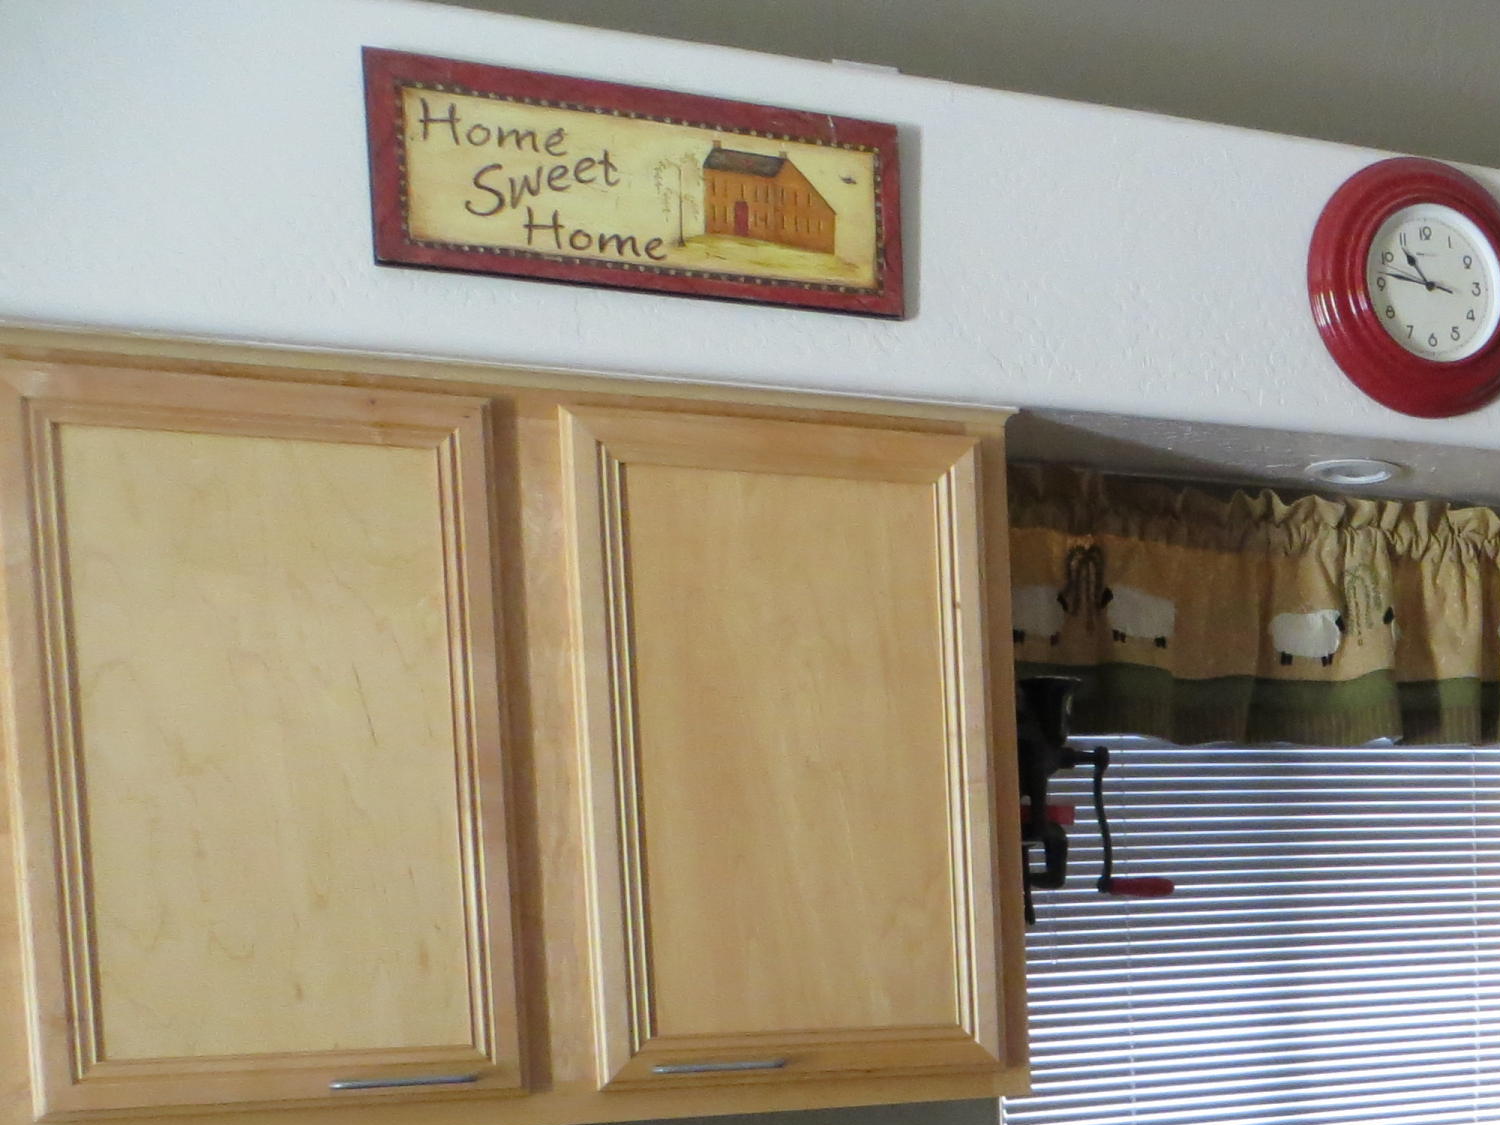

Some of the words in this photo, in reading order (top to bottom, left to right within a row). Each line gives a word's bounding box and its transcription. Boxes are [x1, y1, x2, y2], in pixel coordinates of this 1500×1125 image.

[418, 97, 568, 156] Home
[464, 149, 622, 218] Sweet
[522, 205, 669, 261] Home
[1419, 226, 1432, 240] 12
[1381, 251, 1394, 266] 10
[1462, 255, 1473, 270] 2
[1376, 276, 1387, 292] 9
[1471, 281, 1482, 297] 3
[1385, 305, 1396, 319] 8
[1466, 308, 1476, 322] 4
[1406, 325, 1415, 339] 7
[1450, 326, 1461, 341] 5
[1427, 333, 1438, 347] 6
